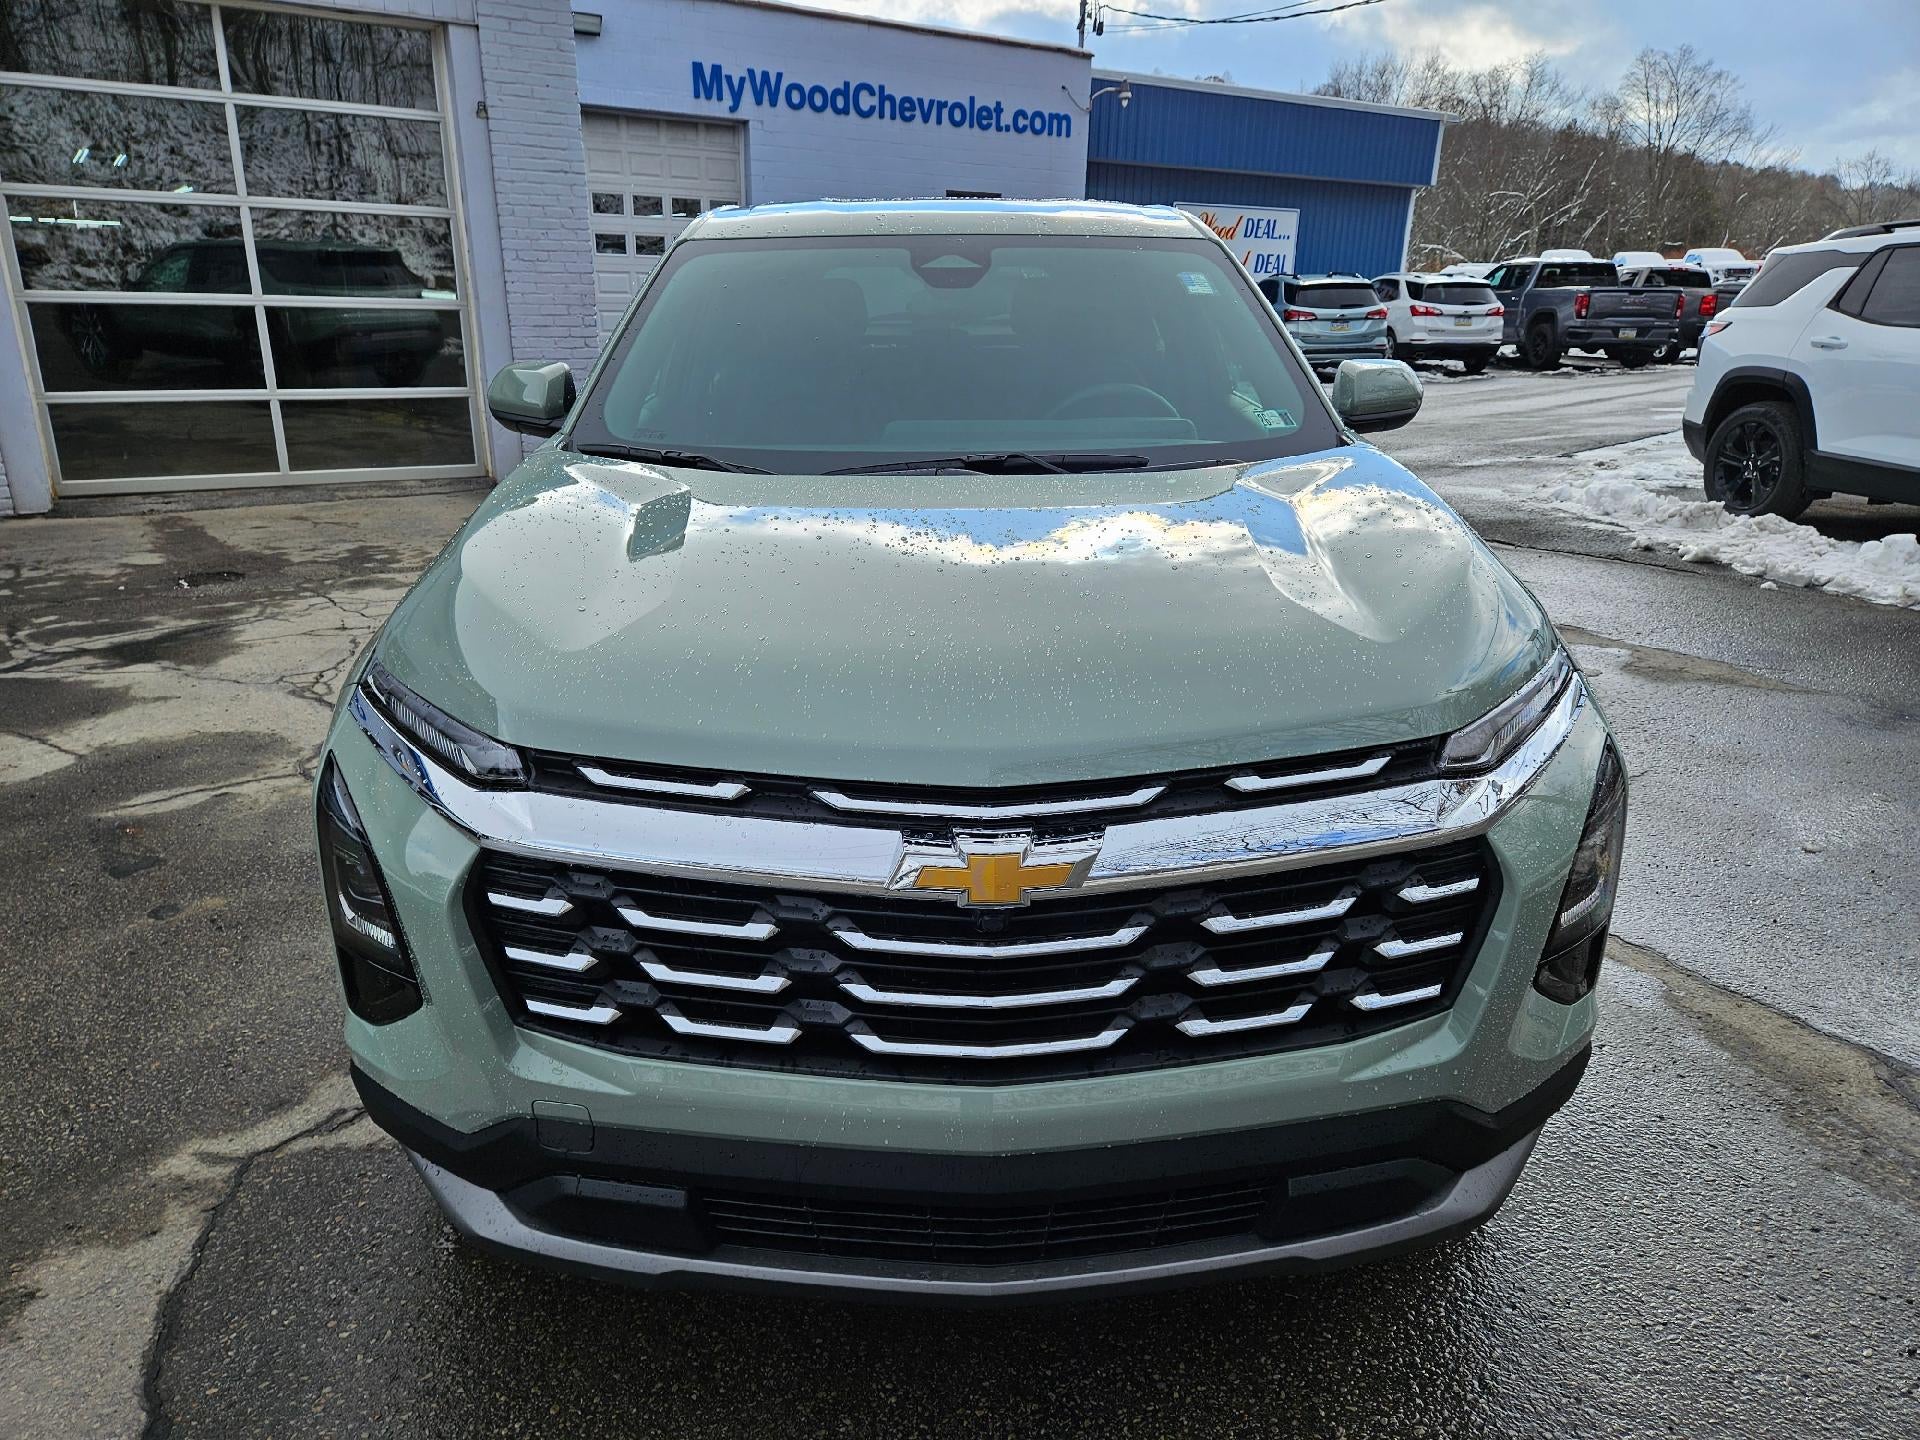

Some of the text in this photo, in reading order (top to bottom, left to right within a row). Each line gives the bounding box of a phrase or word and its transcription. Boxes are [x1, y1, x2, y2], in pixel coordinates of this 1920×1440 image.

[692, 61, 1072, 138] MyWoodChevrolet.com
[1243, 217, 1290, 240] DEAL...
[1253, 253, 1287, 274] DEAL
